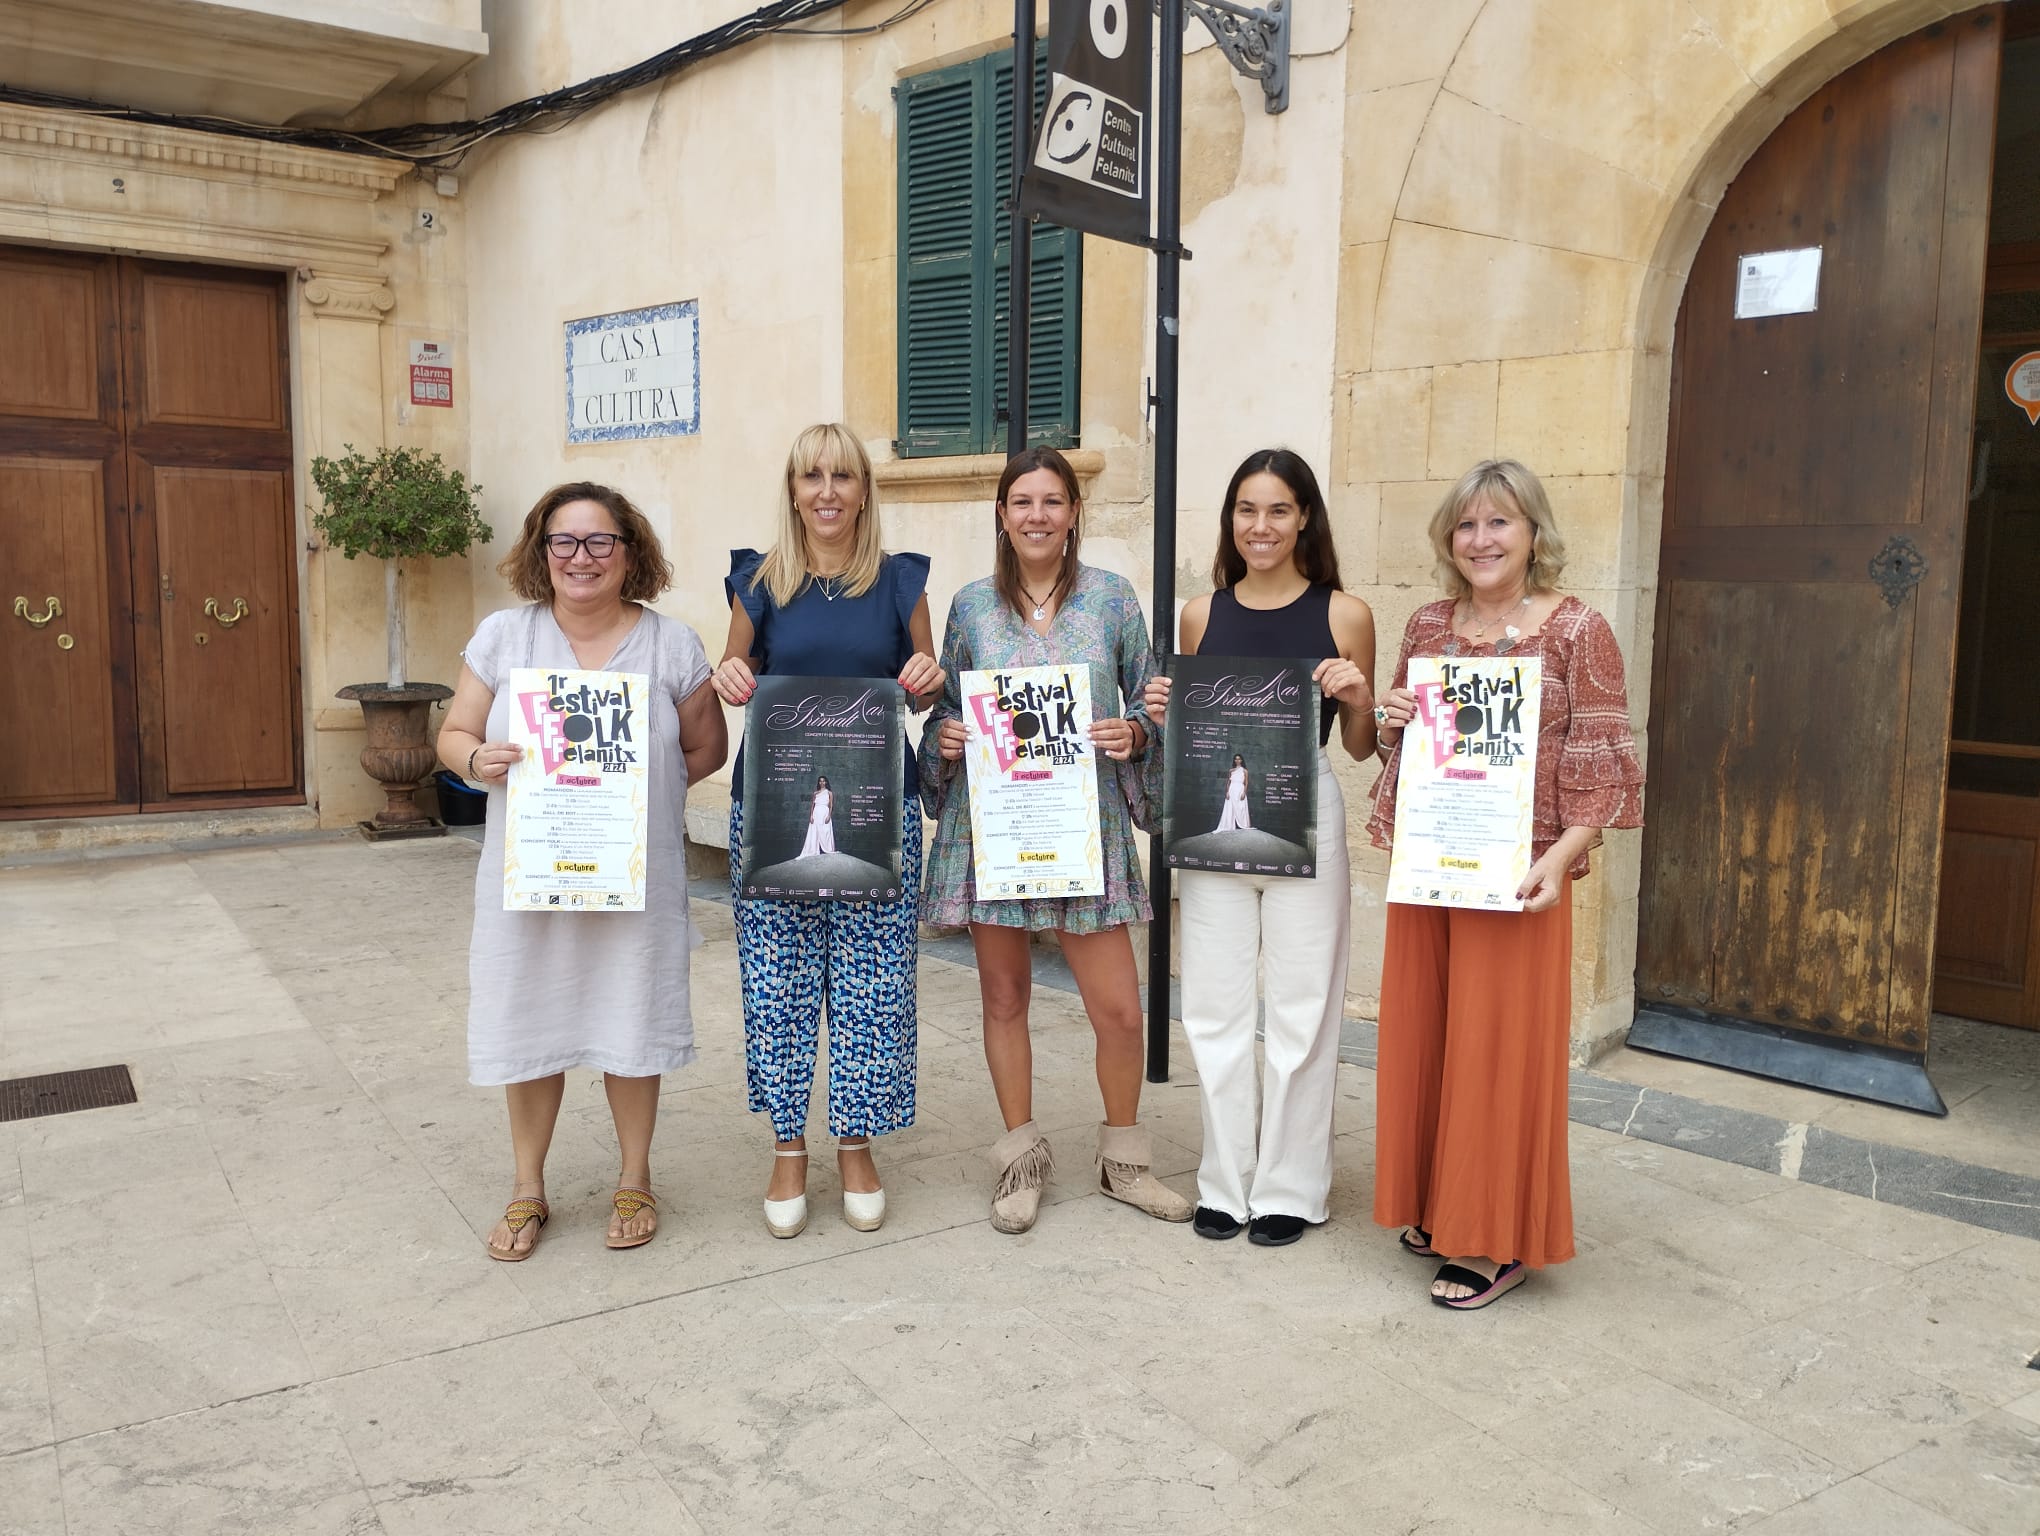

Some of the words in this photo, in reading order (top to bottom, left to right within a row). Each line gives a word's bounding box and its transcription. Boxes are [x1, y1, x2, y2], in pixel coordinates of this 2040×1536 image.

[1104, 110, 1132, 136] Centre
[1101, 134, 1136, 162] Cultural
[1095, 156, 1135, 184] Felanitx
[112, 178, 125, 194] 2
[422, 212, 433, 229] 2
[601, 327, 661, 364] CASA
[413, 367, 449, 379] Alarma
[625, 368, 638, 383] DE
[585, 387, 679, 425] CULTURA
[547, 674, 568, 696] 1r
[994, 674, 1012, 696] 1r
[1441, 664, 1460, 686] 1r
[564, 863, 596, 872] octubre
